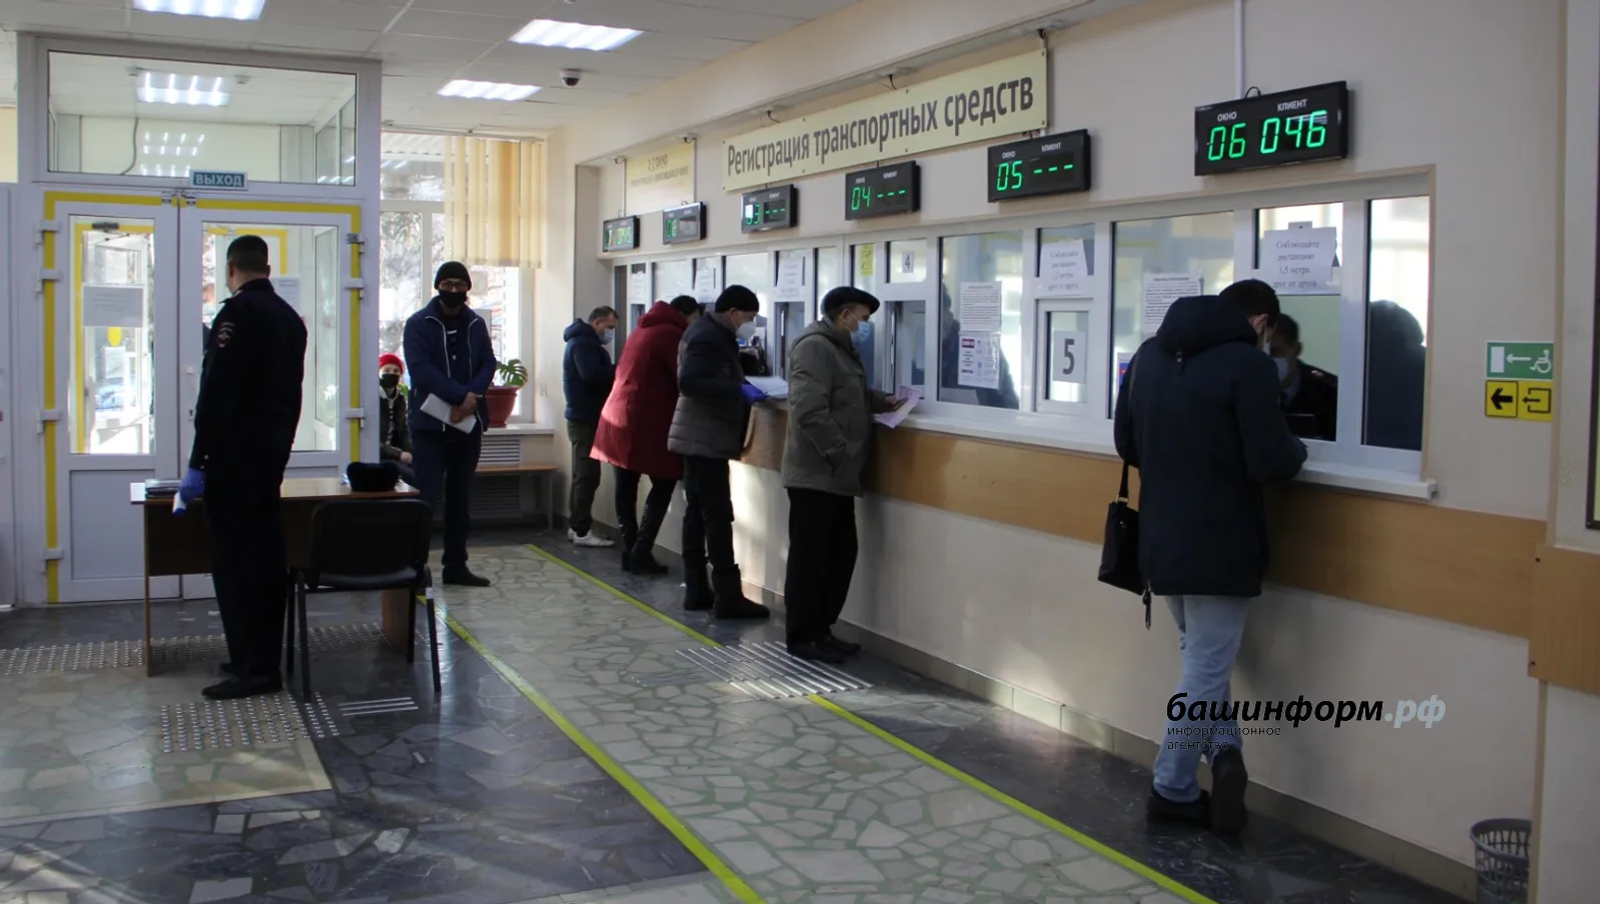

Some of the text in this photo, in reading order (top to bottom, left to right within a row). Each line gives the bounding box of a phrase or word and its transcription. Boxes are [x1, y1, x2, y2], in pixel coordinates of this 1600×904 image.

[1217, 98, 1308, 122] ОКНО КЛИЕНТ
[727, 76, 1033, 176] Регистрация транспортных средств
[1208, 110, 1328, 161] 06 046
[1002, 142, 1061, 159] ОКНО КЛИЕНТ
[195, 173, 243, 187] ВЫХОД
[996, 160, 1022, 191] 05
[851, 186, 871, 211] 04
[1276, 240, 1320, 249] Соблюдайте
[904, 254, 911, 269] 4
[1062, 338, 1075, 375] 5
